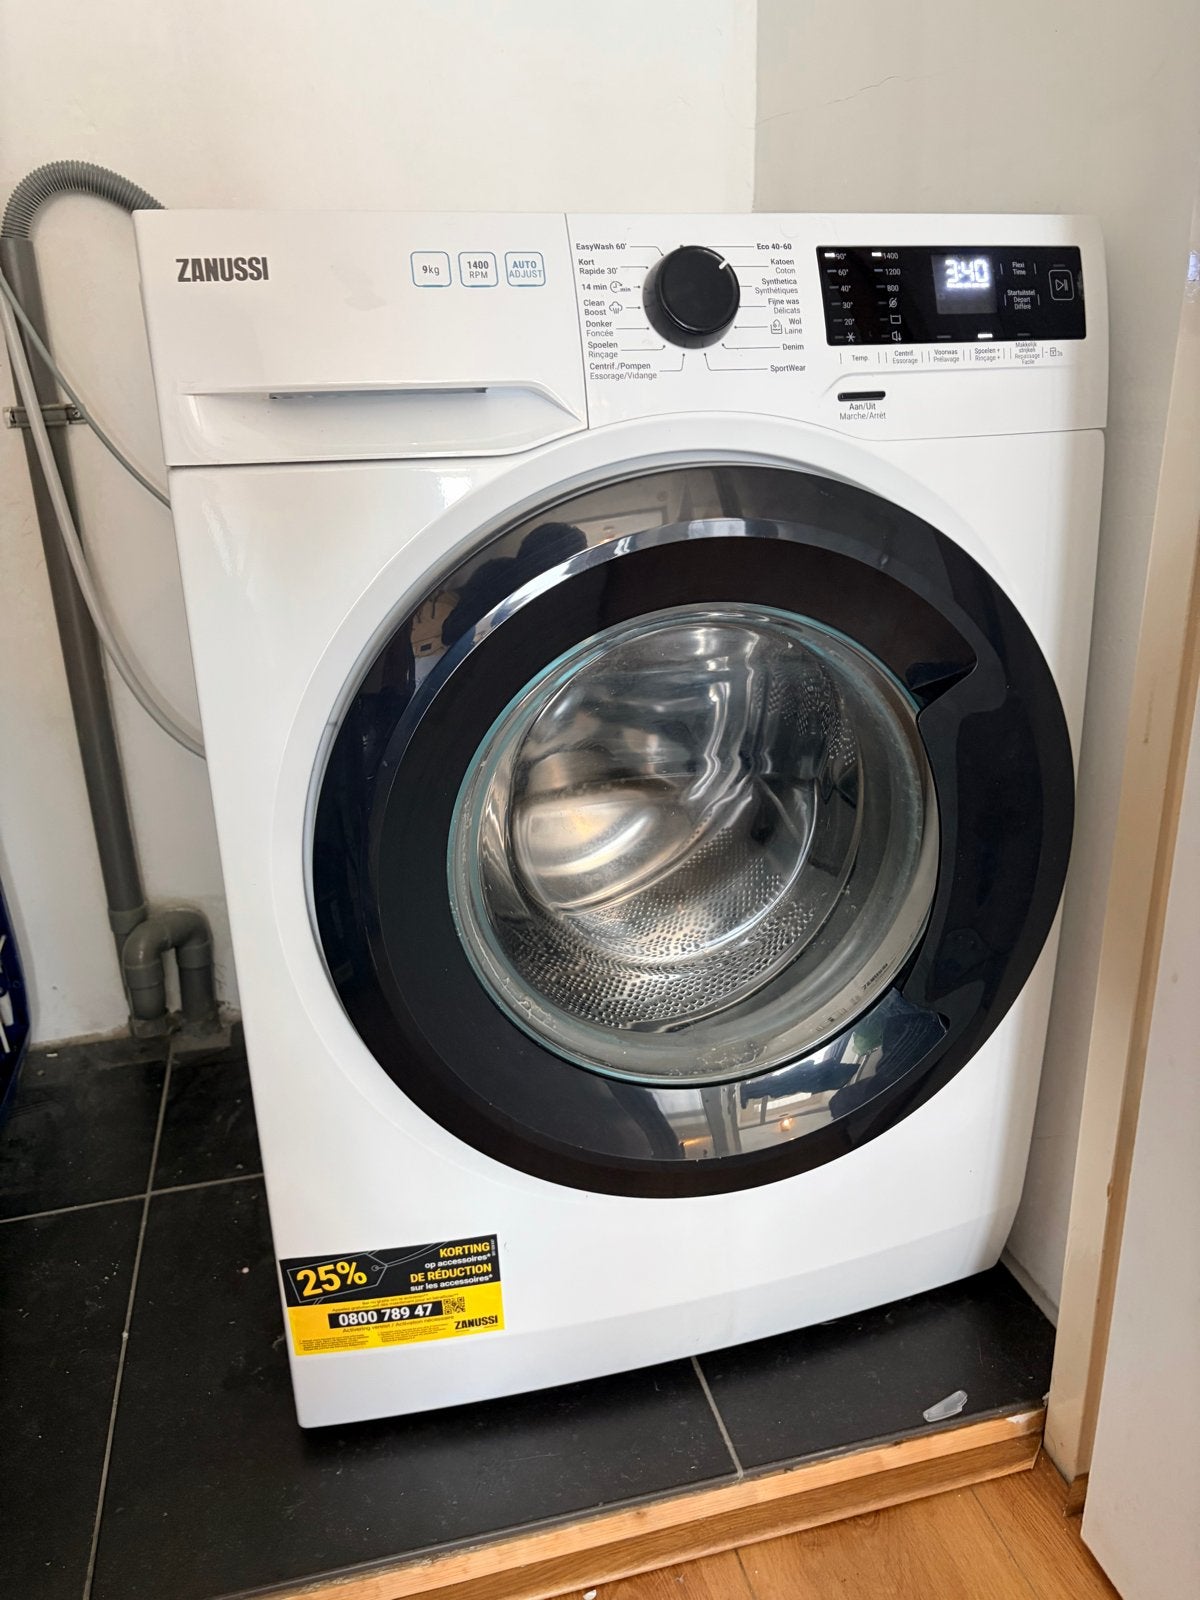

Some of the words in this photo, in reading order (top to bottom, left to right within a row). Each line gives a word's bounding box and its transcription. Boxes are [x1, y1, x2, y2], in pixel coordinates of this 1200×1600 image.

[576, 243, 614, 251] EasyWash
[882, 252, 899, 260] 1400
[466, 260, 489, 270] 1400
[512, 260, 537, 269] AUTO
[578, 258, 594, 266] Kort
[175, 256, 270, 282] ZANUSSI
[422, 264, 440, 276] 9kg
[579, 268, 605, 276] Rapide
[885, 268, 901, 276] 1200
[944, 259, 990, 282] 3:40
[469, 270, 488, 279] RPM
[508, 270, 543, 278] ADJUST
[762, 278, 797, 286] Synthetica
[755, 286, 798, 295] Synthétiques
[886, 284, 899, 292] 800
[768, 298, 784, 306] Fijne
[584, 308, 606, 316] Boost
[586, 320, 612, 328] Donker
[586, 329, 614, 337] Foncée
[588, 341, 618, 350] Spoelen
[588, 351, 618, 359] Rinçage
[934, 348, 958, 356] Voorwas
[892, 357, 918, 365] Essorage
[589, 362, 651, 371] Centrif./Pompen
[770, 364, 806, 374] SportWear
[590, 372, 658, 380] Essorage/Vidange
[849, 402, 876, 410] Aan/Uit
[840, 412, 887, 420] Marche/Arrêt
[440, 1241, 490, 1258] KORTING
[424, 1262, 436, 1270] op
[410, 1272, 426, 1283] DE
[427, 1262, 492, 1281] RÉDUCTION
[296, 1260, 368, 1298] 25%
[410, 1284, 424, 1292] sur
[426, 1282, 438, 1290] les
[338, 1310, 378, 1326] 0800
[380, 1306, 410, 1322] 789
[414, 1303, 433, 1317] 47
[454, 1315, 498, 1330] ZANUSSI
